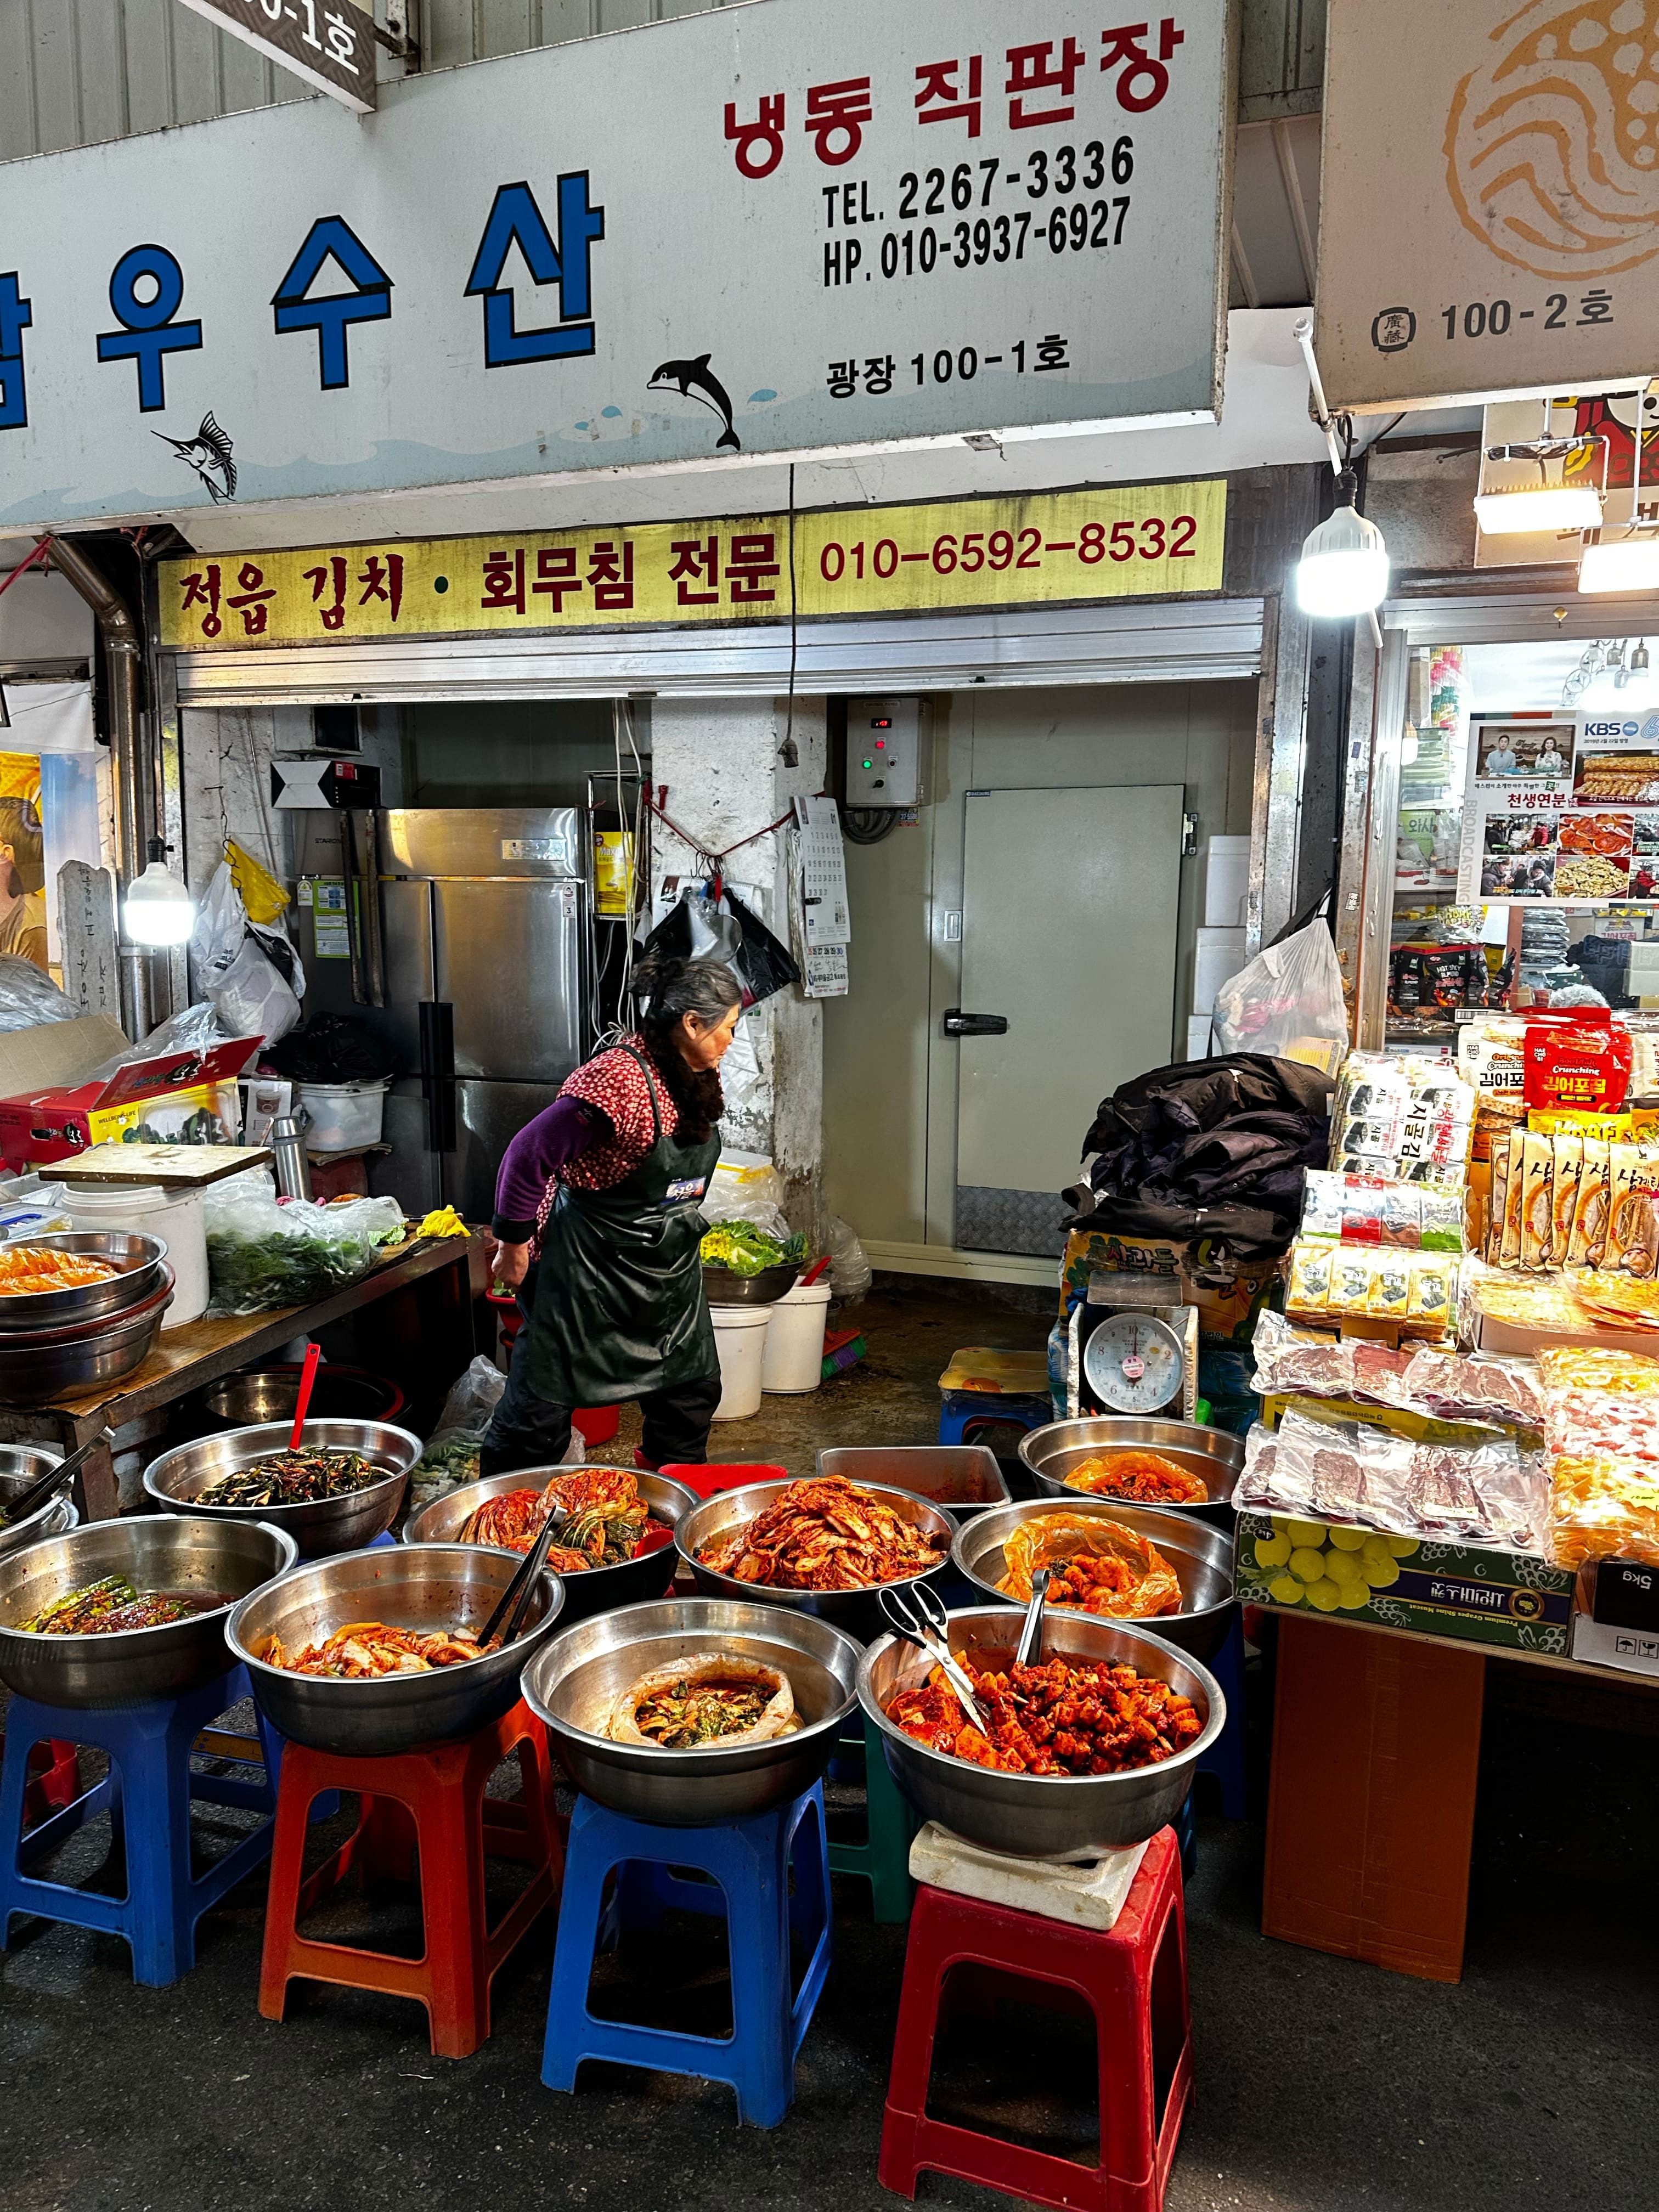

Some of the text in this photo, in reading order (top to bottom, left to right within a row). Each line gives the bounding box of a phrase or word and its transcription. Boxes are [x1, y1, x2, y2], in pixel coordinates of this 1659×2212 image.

[724, 18, 1184, 179] 냉동 직판장
[822, 136, 1134, 228] TEL. 2267-3336
[1441, 289, 1613, 341] 100-2호
[826, 334, 1070, 398] 광장 100-1호
[179, 515, 1198, 639] 정읍 김치 회무침 전문 010-6592-8532
[1585, 723, 1621, 736] KBS
[1507, 793, 1566, 809] 천생연분
[1458, 800, 1477, 902] BROADCASTING
[837, 947, 843, 955] 30
[1487, 1061, 1524, 1071] Crunchi
[1552, 1065, 1600, 1076] Crunching
[1480, 1073, 1524, 1087] 김어포
[1401, 1103, 1427, 1159] 시골김
[1128, 1325, 1138, 1335] 10
[1098, 1346, 1104, 1356] 8
[1164, 1350, 1172, 1360] 2
[1110, 1385, 1118, 1395] 6
[1150, 1387, 1158, 1397] 4
[1623, 1571, 1653, 1589] 5kg
[1430, 1582, 1505, 1608] 샤인머스켓
[1409, 1602, 1519, 1627] Premium Grapes Shine Muscat
